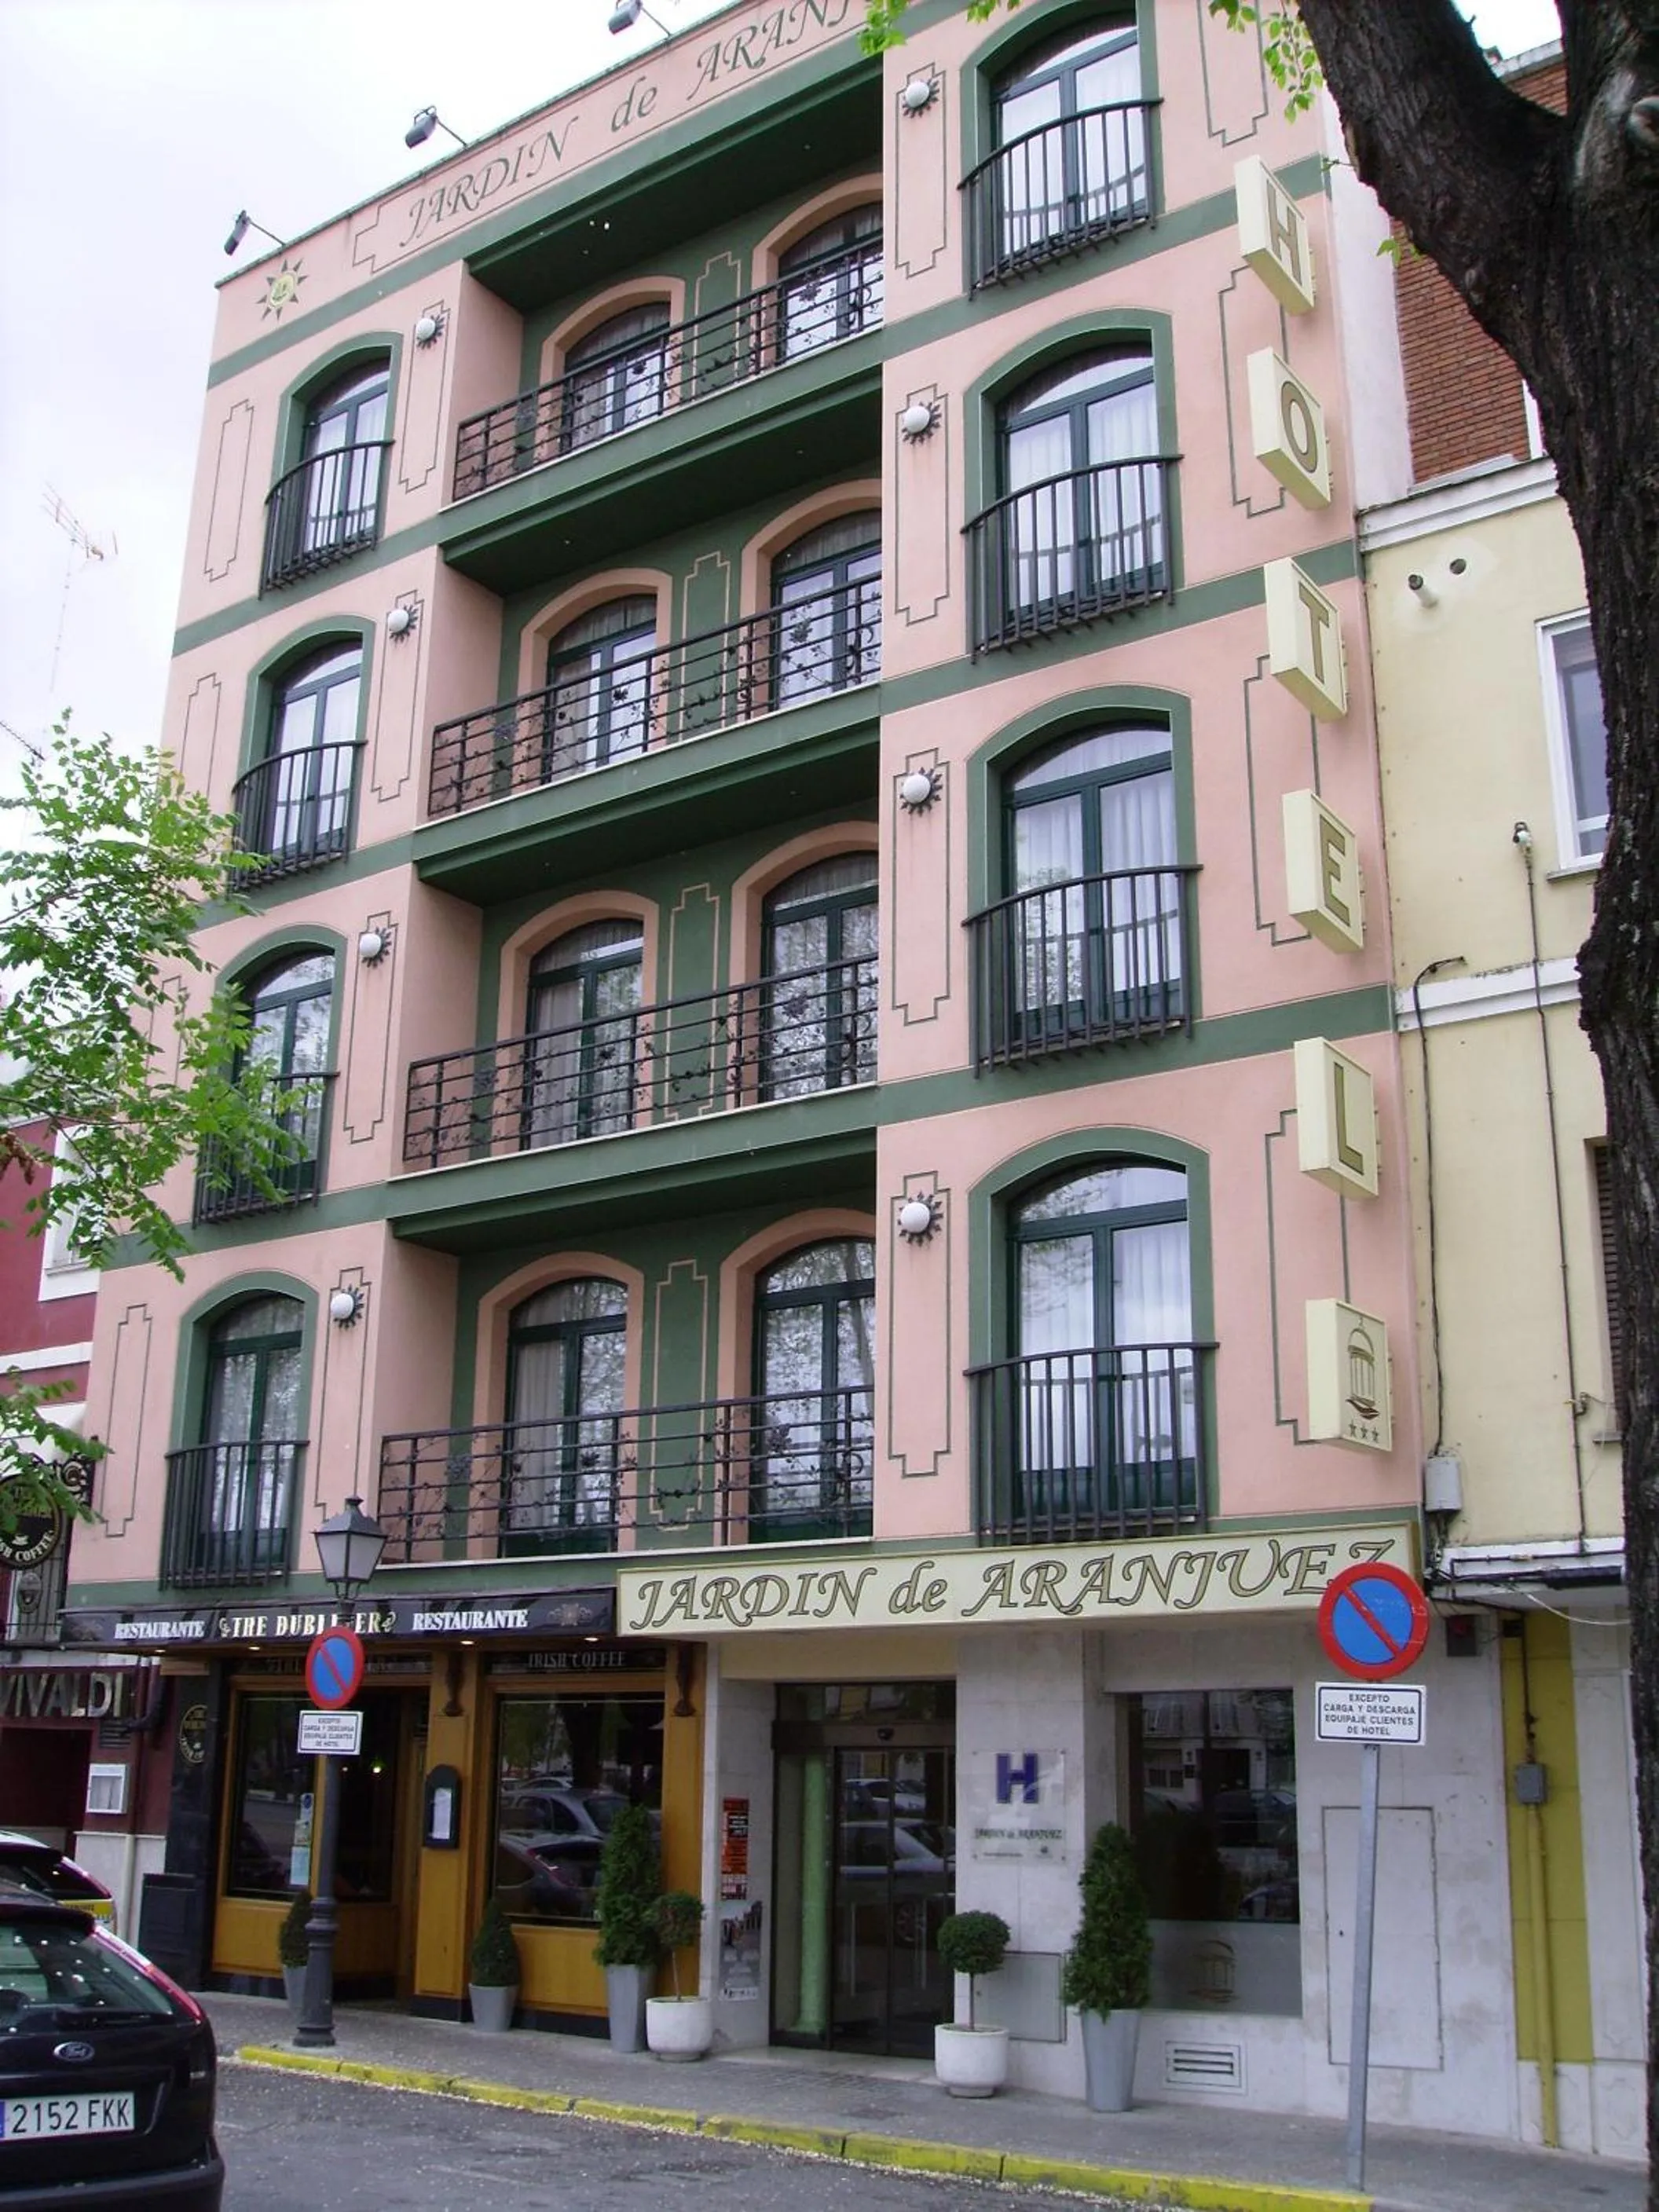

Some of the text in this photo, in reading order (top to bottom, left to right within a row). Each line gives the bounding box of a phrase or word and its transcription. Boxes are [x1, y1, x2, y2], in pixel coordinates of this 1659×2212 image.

[399, 115, 580, 247] JARDIN
[611, 76, 657, 133] de
[1266, 177, 1364, 1176] HOTEL
[629, 1566, 877, 1631] JARDIN
[888, 1559, 948, 1614] de
[115, 1620, 206, 1640] RESTAURANTE
[232, 1615, 268, 1639] THE
[412, 1608, 529, 1631] RESTAURANTE
[1324, 1703, 1415, 1715] CARGA Y DESCARGA
[1348, 1693, 1390, 1703] EXCEPTO
[1324, 1714, 1414, 1726] EQUIPAJE CLIENTES
[1346, 1726, 1390, 1736] DE HOTEL
[996, 1752, 1038, 1804] H
[12, 2098, 130, 2133] 2152 FKK
